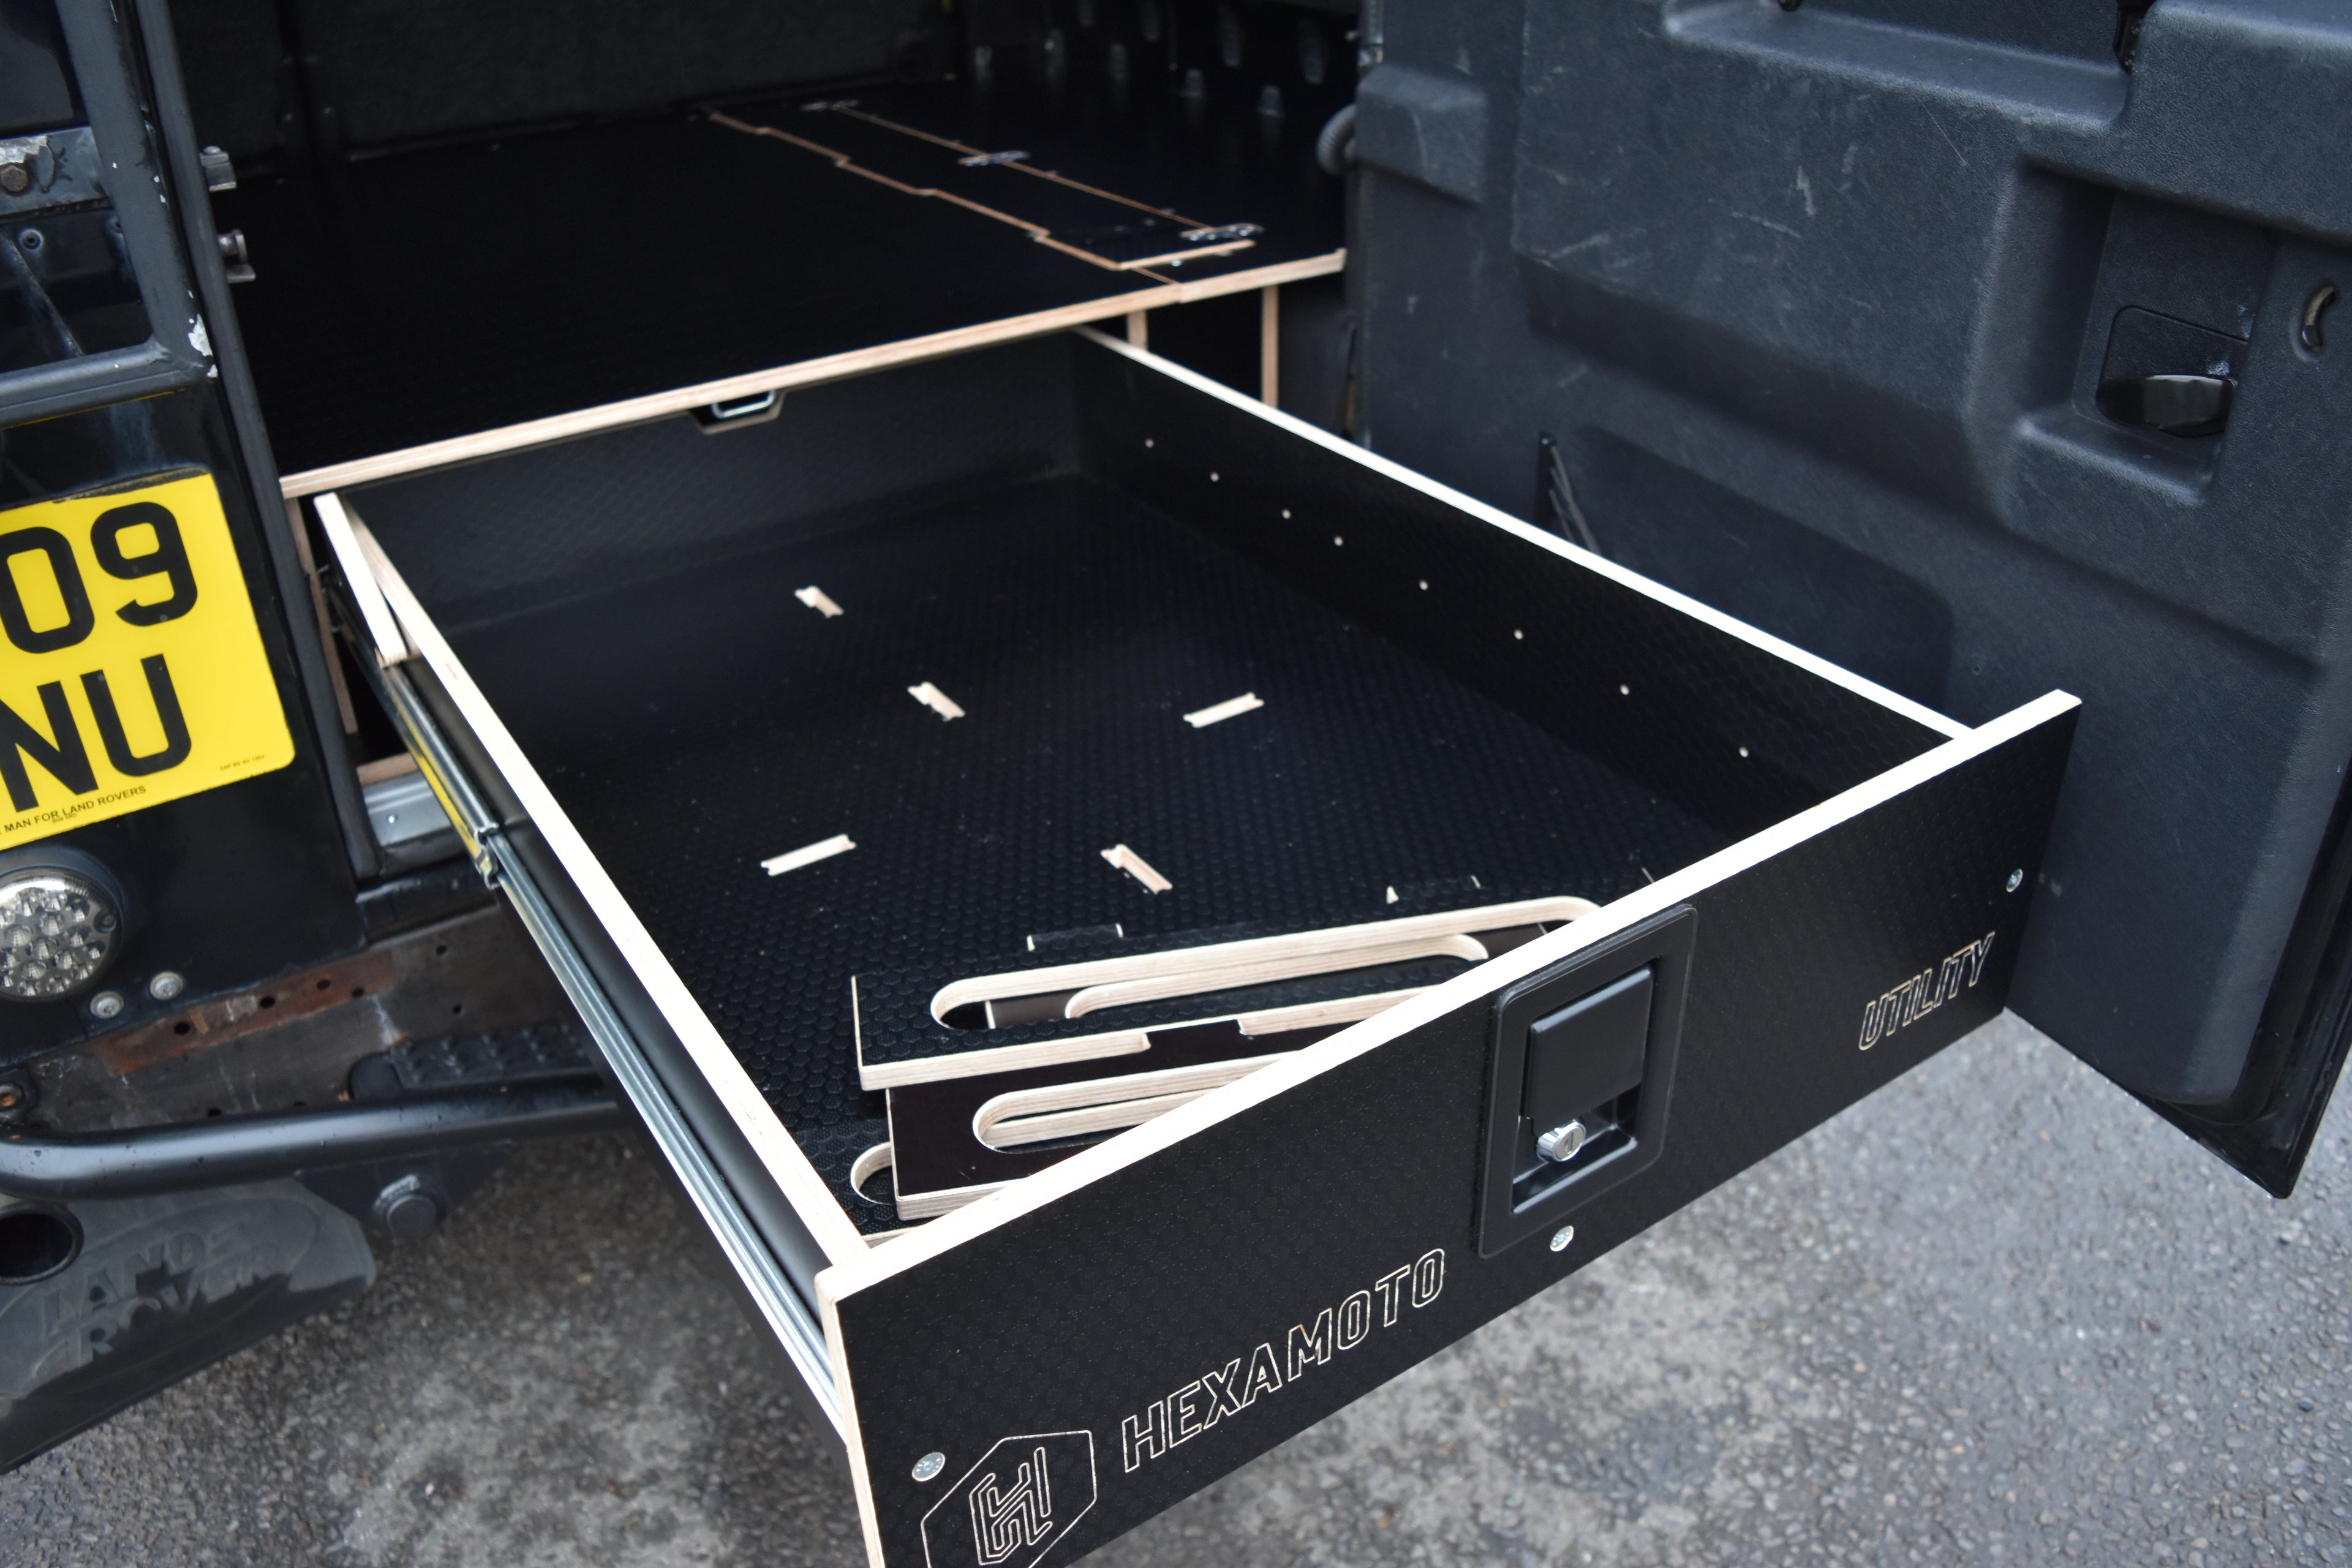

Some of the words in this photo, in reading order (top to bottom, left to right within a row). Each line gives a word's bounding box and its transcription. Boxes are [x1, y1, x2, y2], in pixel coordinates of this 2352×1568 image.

[0, 502, 198, 654] 09
[0, 653, 192, 813] NU
[4, 818, 31, 832] MAN
[34, 810, 59, 824] FOR
[61, 801, 94, 816] LAND
[97, 786, 146, 805] ROVERS
[1858, 931, 1996, 1051] UTILITY
[1121, 1248, 1445, 1473] HEXAMOTO
